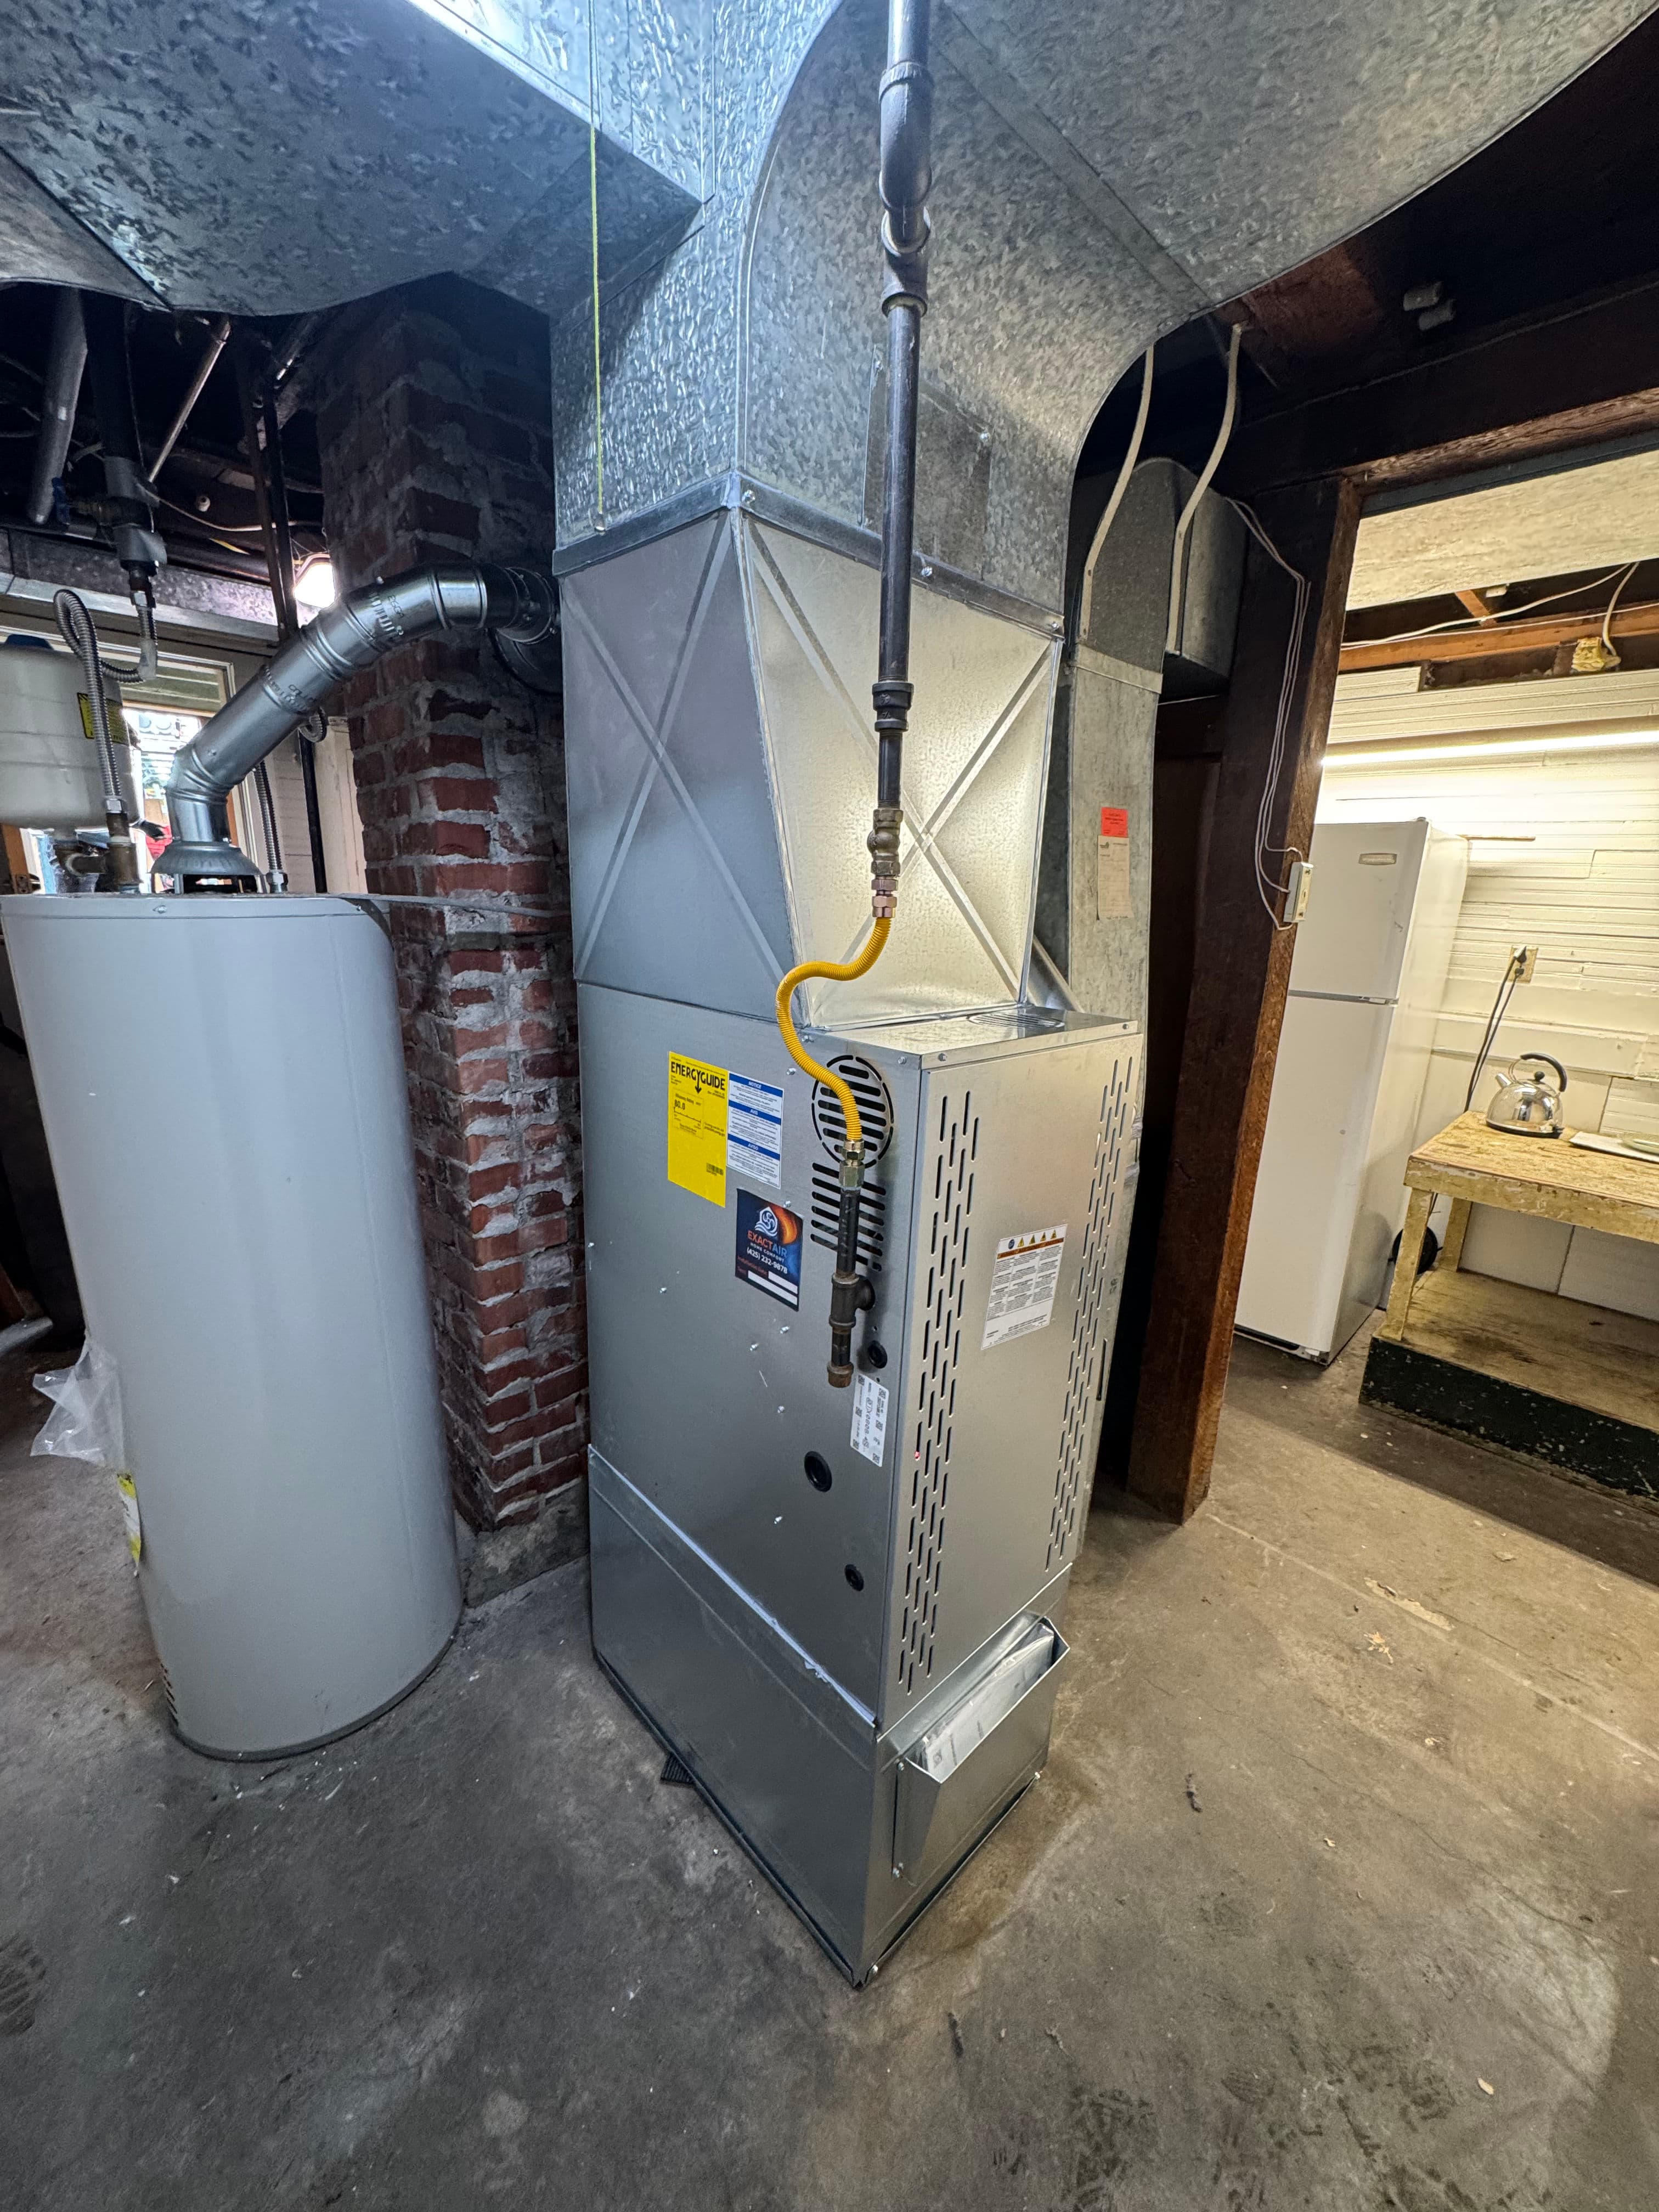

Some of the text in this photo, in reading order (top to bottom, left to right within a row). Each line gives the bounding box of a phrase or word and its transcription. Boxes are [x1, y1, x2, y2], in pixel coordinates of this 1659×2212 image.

[671, 1061, 725, 1091] ENERGYGUIDE
[748, 1081, 761, 1089] NOTICE
[747, 1246, 760, 1260] (425)
[751, 1242, 785, 1263] HOME COMFORT
